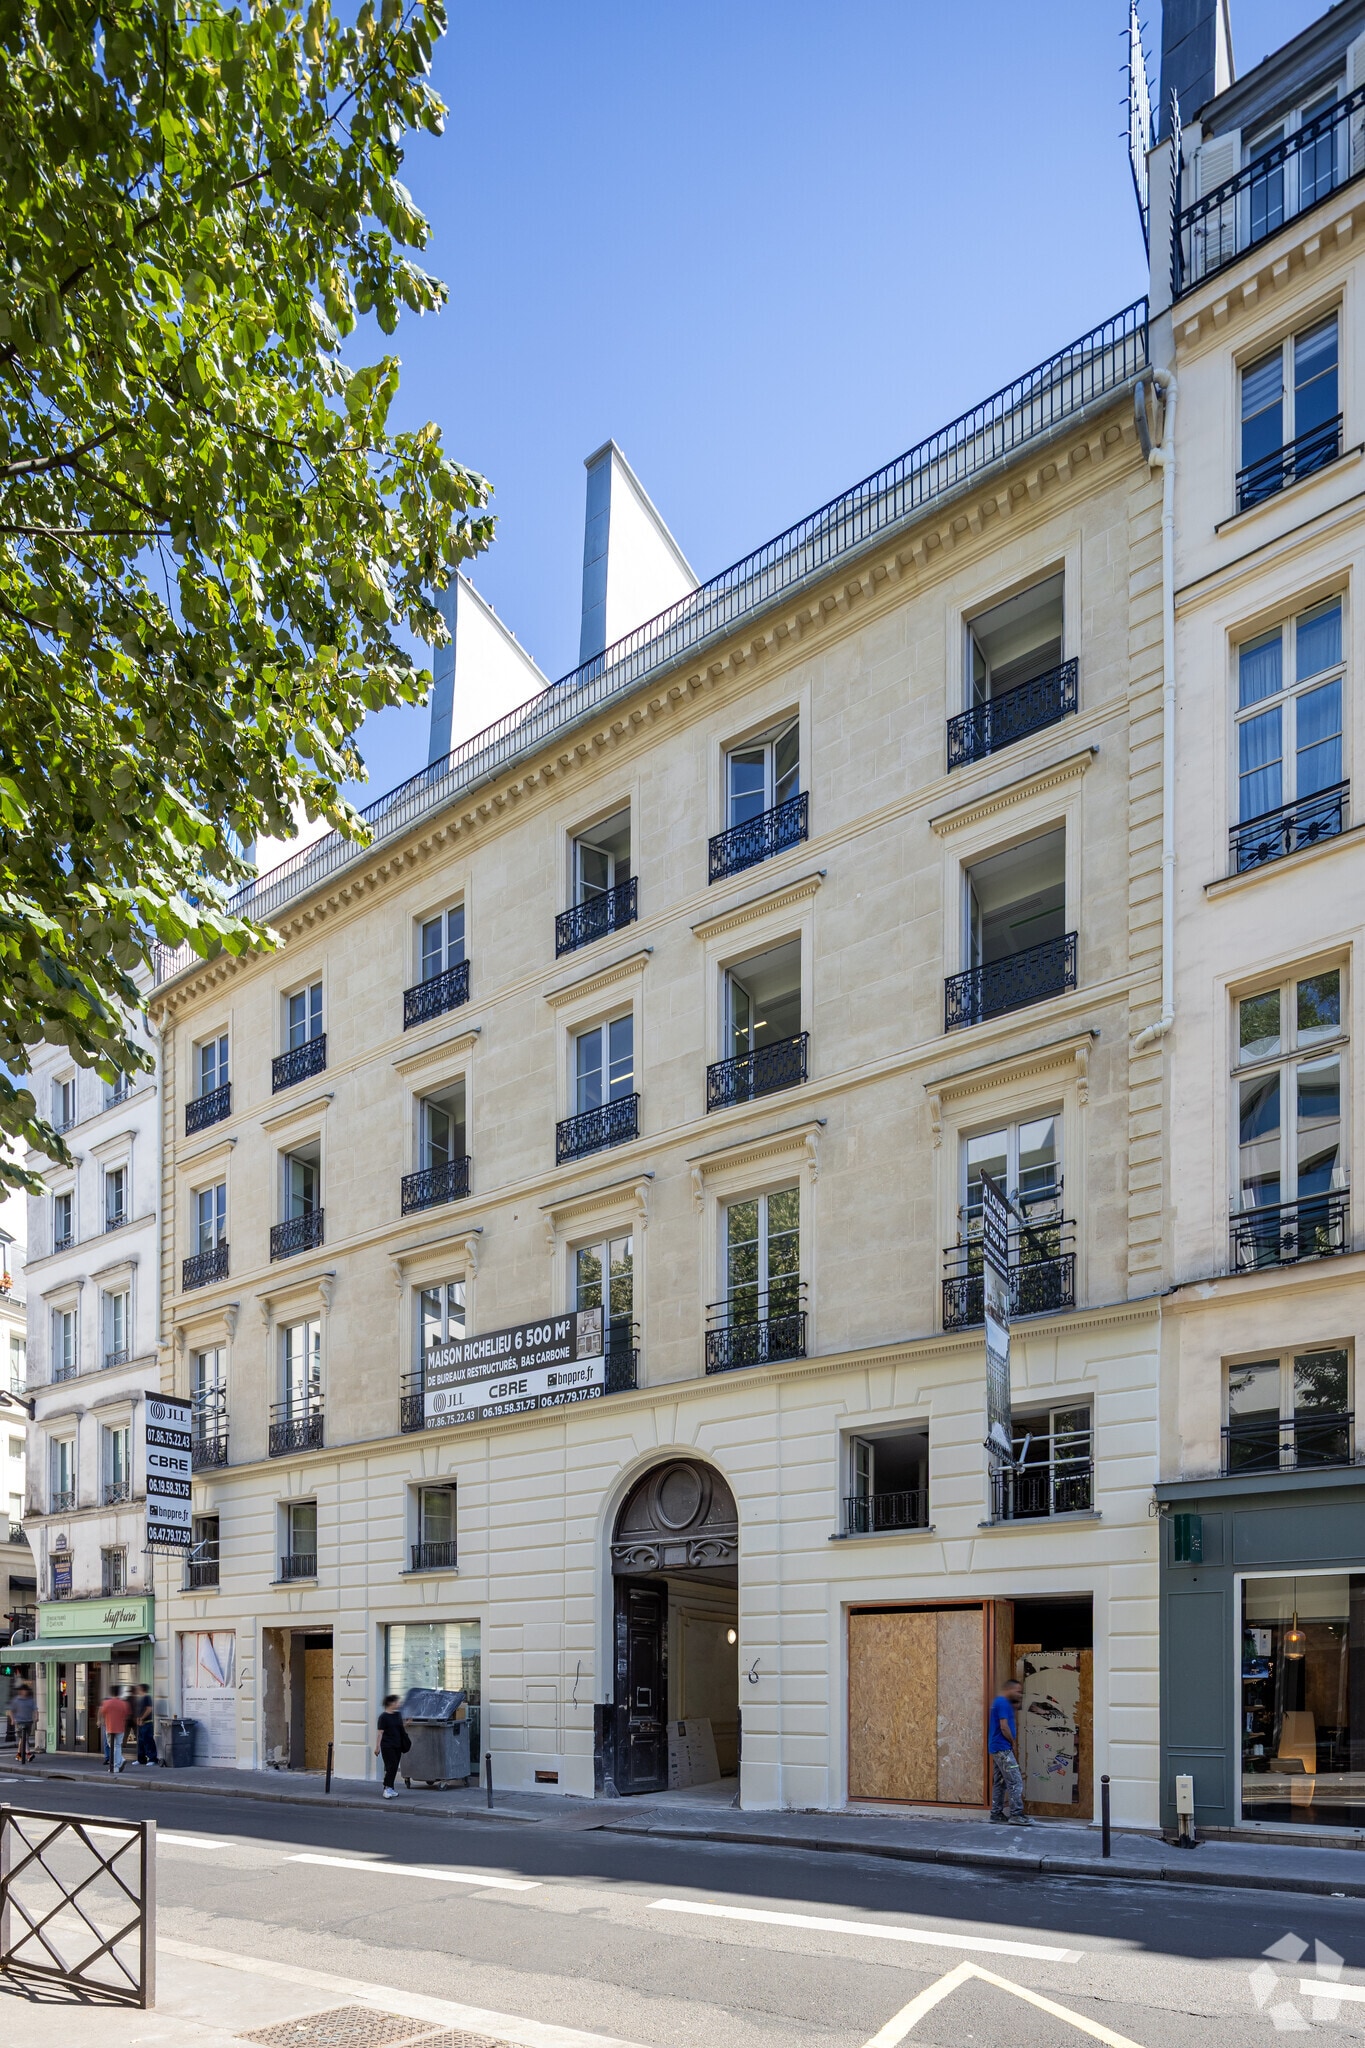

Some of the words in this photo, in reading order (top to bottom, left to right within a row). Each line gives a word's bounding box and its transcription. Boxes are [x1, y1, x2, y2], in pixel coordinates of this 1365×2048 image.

[428, 1349, 462, 1369] MAISON
[466, 1334, 511, 1360] RICHELIEU
[514, 1331, 523, 1350] 6
[526, 1325, 551, 1347] 500
[555, 1321, 570, 1341] M²
[427, 1375, 436, 1387] DE
[437, 1368, 467, 1384] BUREAUX
[521, 1353, 535, 1368] BAS
[536, 1347, 570, 1364] CARBONE
[447, 1392, 465, 1408] JLL
[489, 1379, 528, 1399] CBRE
[558, 1366, 594, 1386] bnppre.fr
[166, 1408, 187, 1422] JLL
[427, 1410, 475, 1429] 07.86.75.22.43
[482, 1399, 536, 1418] 06.19.58.31.75
[541, 1387, 601, 1407] 06.47.79.17.50
[149, 1455, 189, 1471] CBRE
[148, 1478, 190, 1497] 06.19.58.31.75
[158, 1505, 189, 1521] bnppre.fr
[148, 1528, 191, 1544] 06.47.79.17.50
